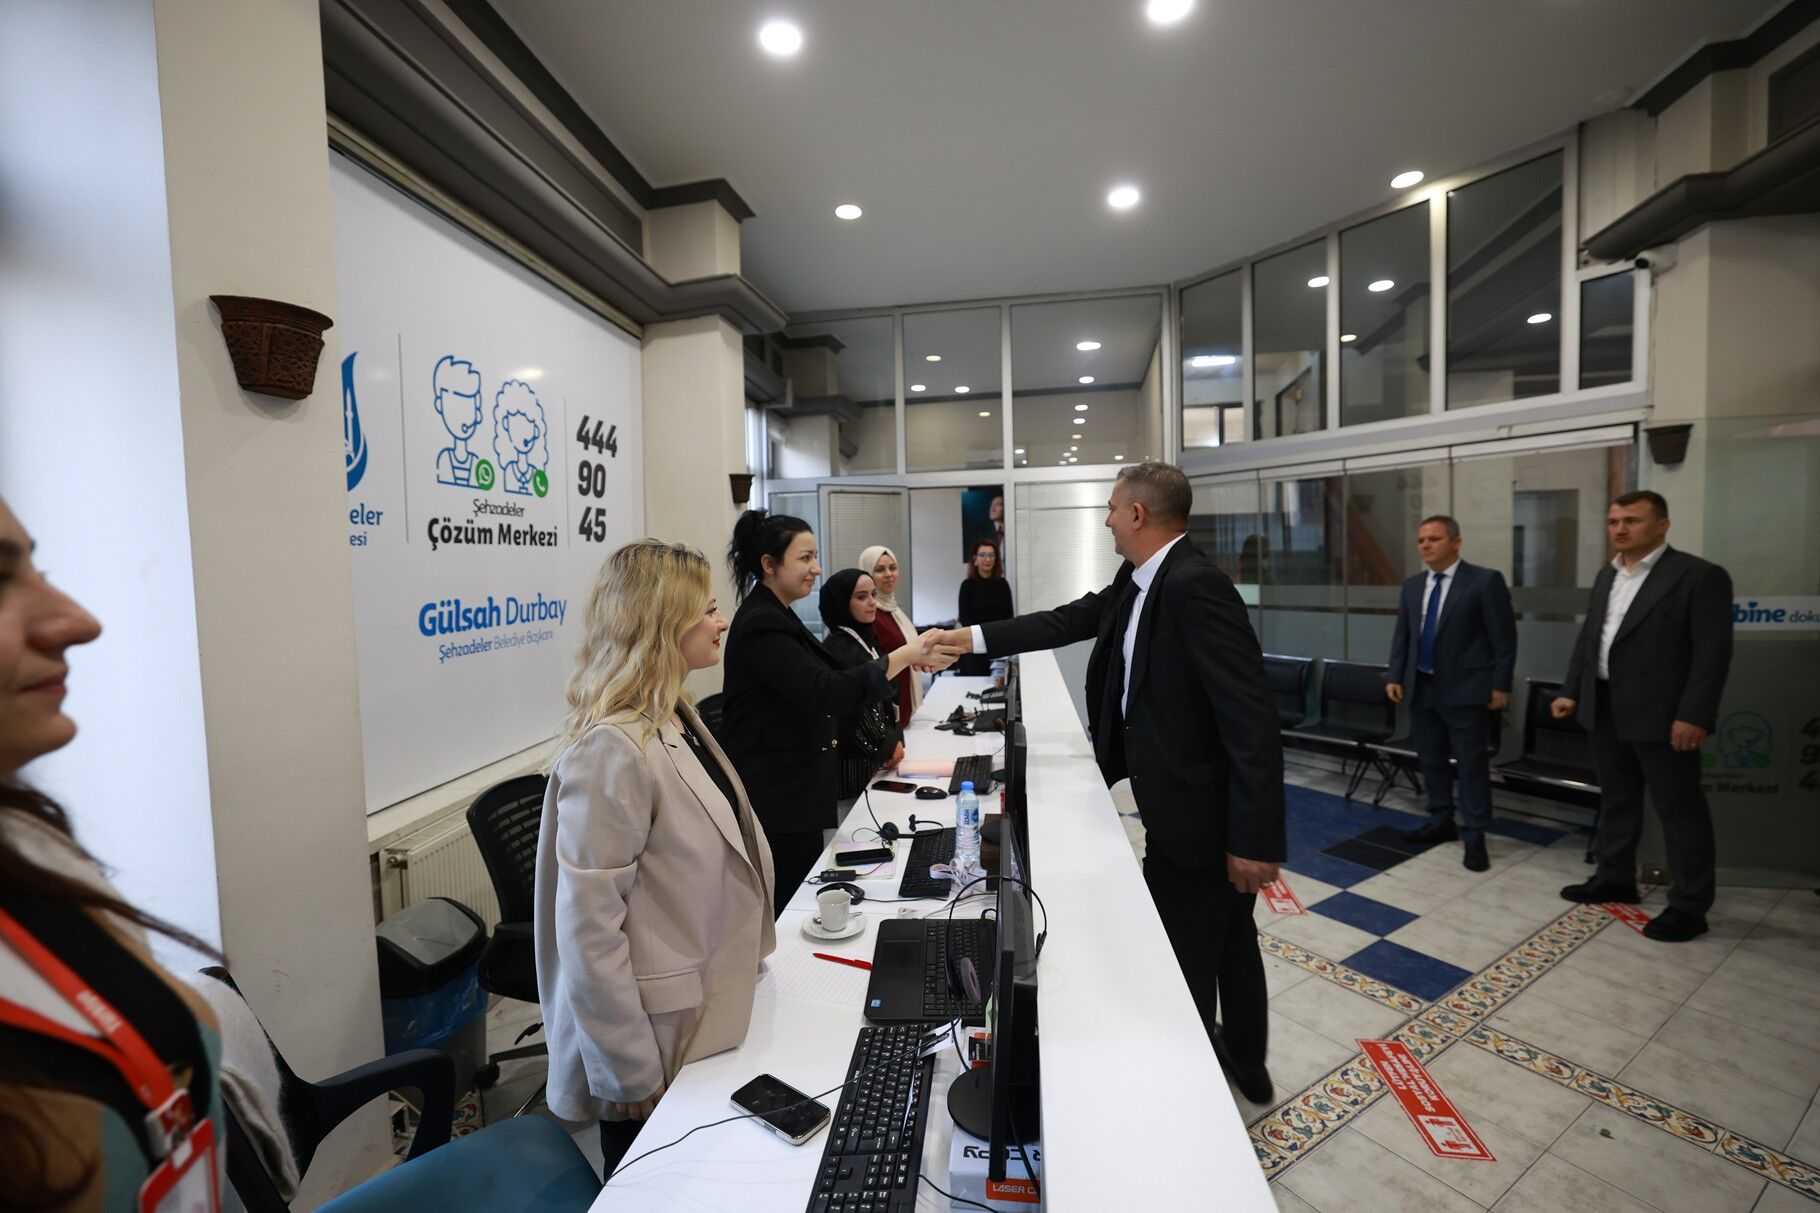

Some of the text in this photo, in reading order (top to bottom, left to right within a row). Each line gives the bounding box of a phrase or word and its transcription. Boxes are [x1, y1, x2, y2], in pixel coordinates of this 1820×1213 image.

[576, 415, 618, 458] 444
[578, 460, 606, 498] 90
[473, 499, 525, 517] Şehzadeler
[579, 506, 606, 542] 45
[428, 517, 558, 551] Çözüm Merkezi
[506, 592, 567, 625] Durbay
[993, 1184, 1025, 1194] LASER
